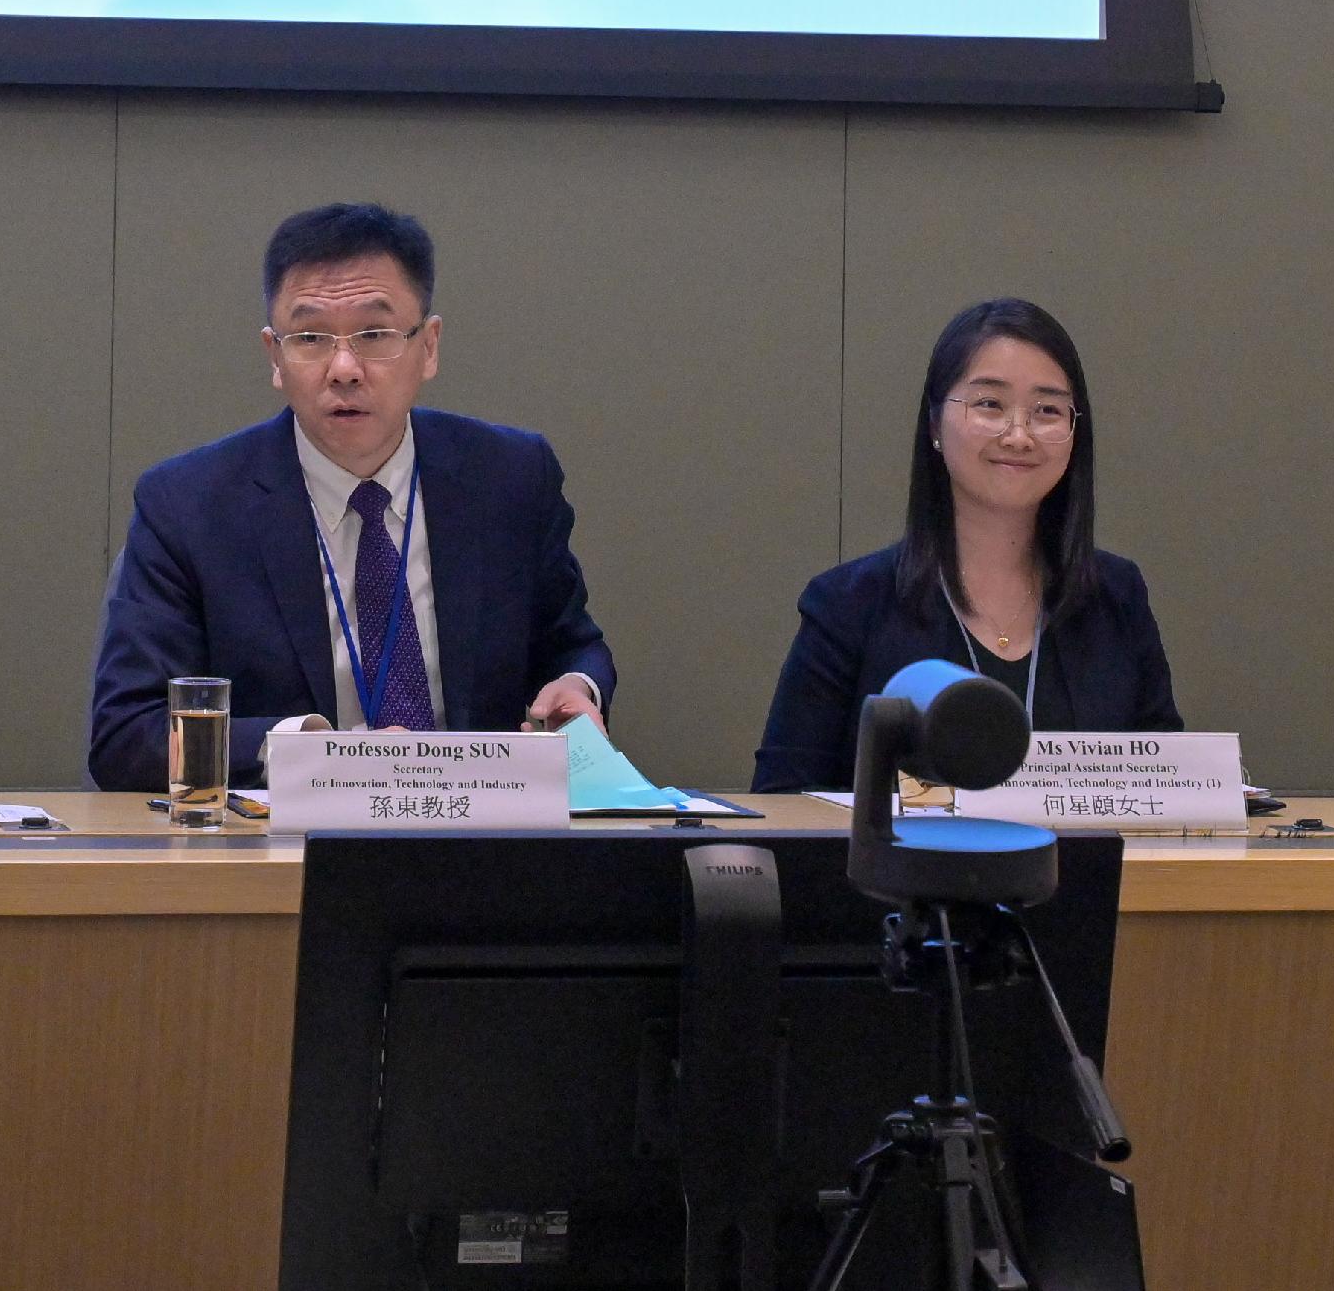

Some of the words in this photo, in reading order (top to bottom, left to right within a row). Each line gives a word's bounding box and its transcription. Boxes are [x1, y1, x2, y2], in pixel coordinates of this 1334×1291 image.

[325, 741, 411, 757] Professor
[416, 742, 464, 762] Dong
[469, 742, 510, 759] SUN
[1036, 740, 1063, 756] Ms
[1067, 740, 1124, 756] Vivian
[1129, 740, 1160, 756] HO
[393, 764, 443, 776] Secretary
[1020, 761, 1071, 776] Principal
[1074, 762, 1123, 773] Assistant
[1126, 762, 1178, 776] Secretary
[311, 778, 327, 788] for
[330, 778, 392, 789] Innovation,
[393, 778, 455, 791] Technology
[457, 779, 478, 789] and
[481, 779, 525, 792] Industry
[999, 777, 1063, 788] nnovation,
[1068, 778, 1127, 790] Technology
[1131, 778, 1152, 788] and
[1155, 778, 1202, 791] Industry
[1206, 778, 1221, 790] (1)
[369, 795, 471, 819] 孫東教授
